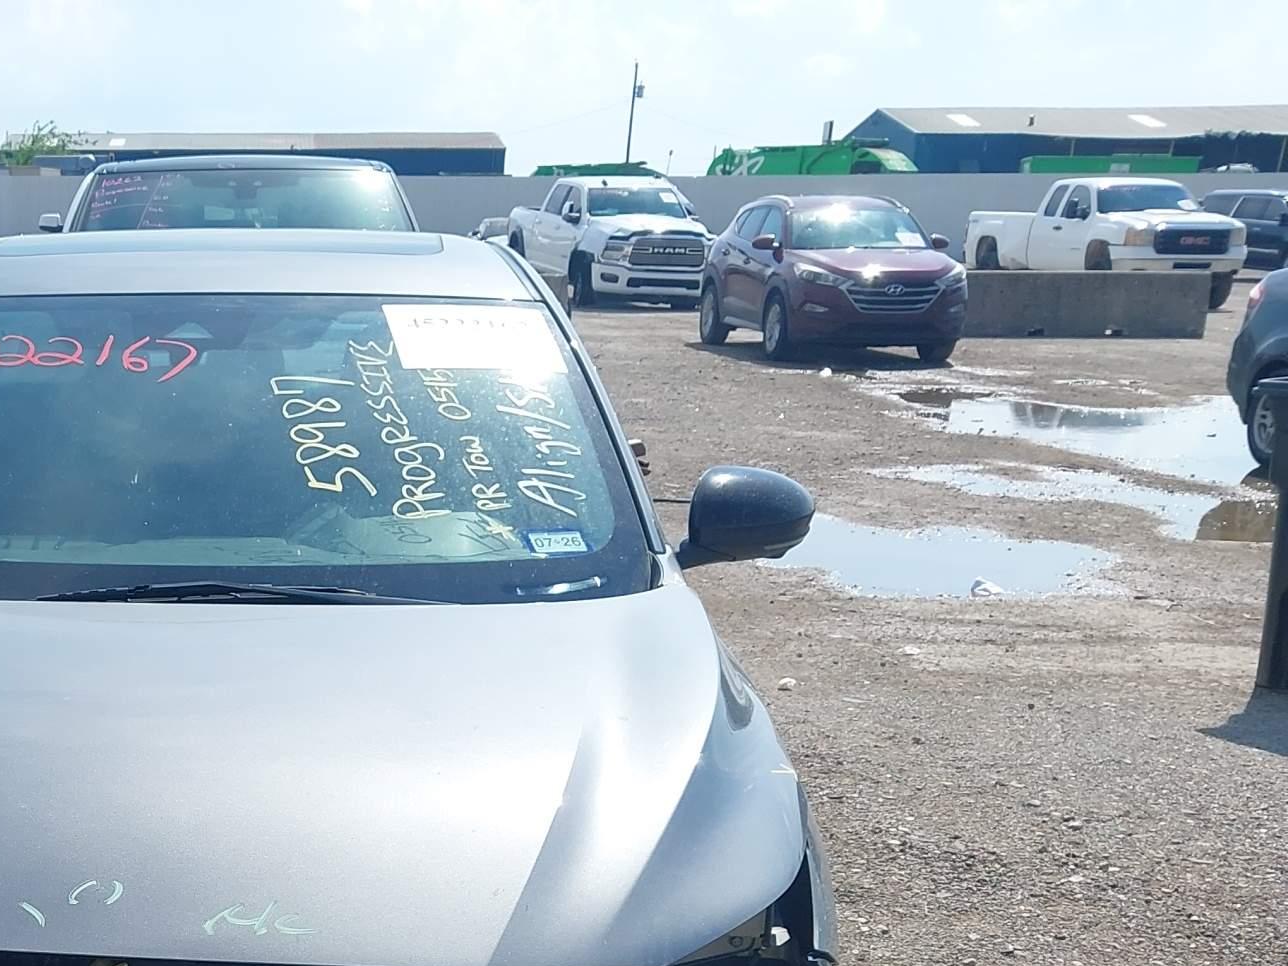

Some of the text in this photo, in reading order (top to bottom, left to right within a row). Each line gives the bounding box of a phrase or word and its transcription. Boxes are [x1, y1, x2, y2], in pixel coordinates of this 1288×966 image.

[1179, 235, 1211, 245] GMC
[653, 246, 686, 255] RAM
[269, 374, 378, 497] 58987
